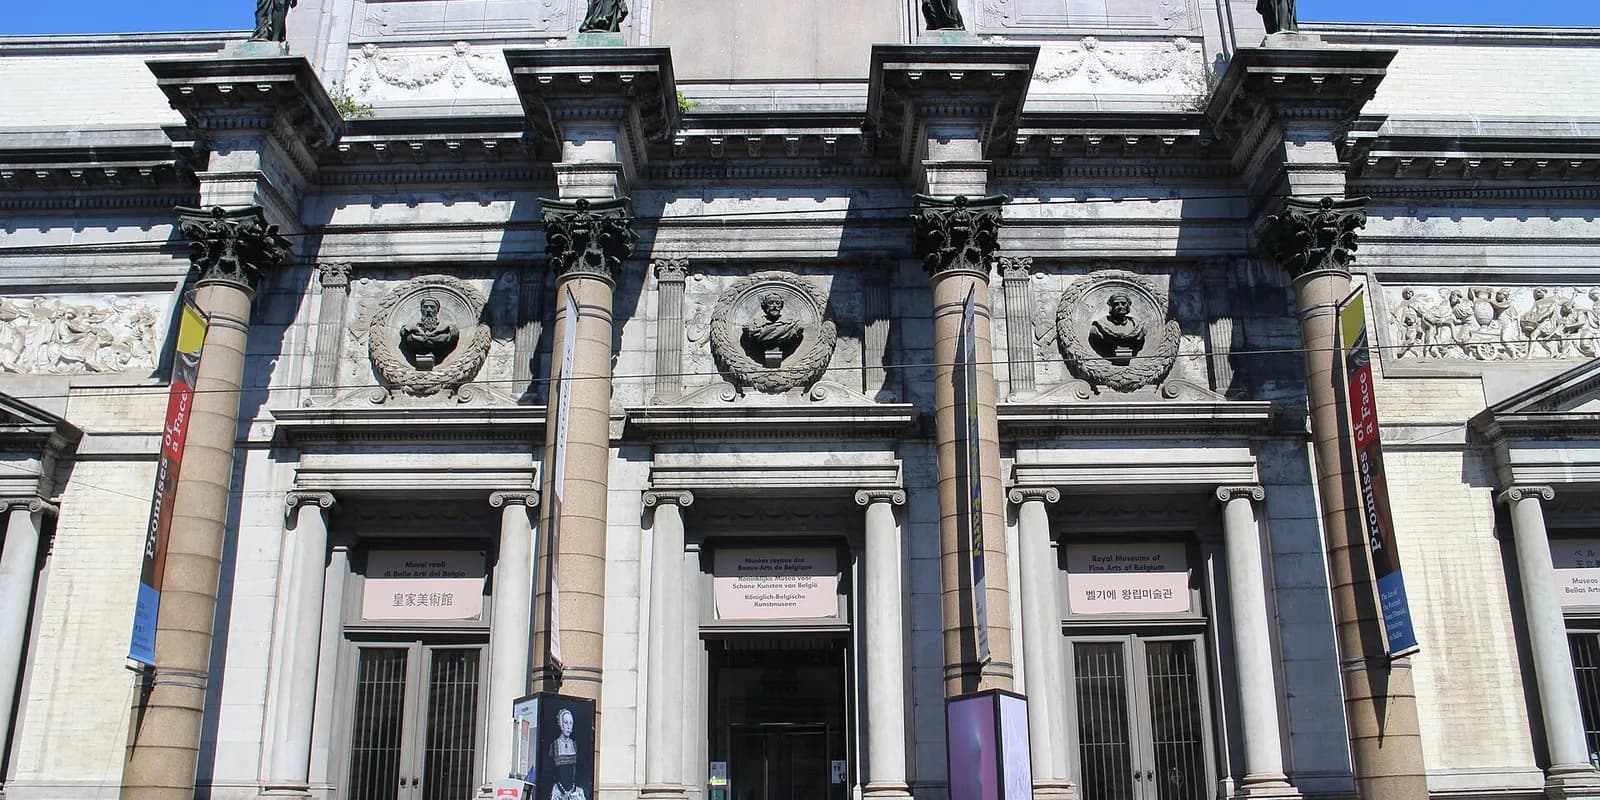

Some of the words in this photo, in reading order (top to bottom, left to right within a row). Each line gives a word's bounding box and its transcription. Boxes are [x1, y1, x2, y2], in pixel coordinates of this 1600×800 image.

[1360, 372, 1371, 421] Face
[174, 389, 188, 436] Face
[1354, 422, 1364, 442] of
[1366, 424, 1374, 435] a
[172, 444, 179, 453] a
[146, 456, 168, 560] Promises
[165, 422, 173, 447] of
[1360, 451, 1382, 553] Promises
[1092, 554, 1113, 563] Royal
[1115, 554, 1150, 562] Museums
[1152, 553, 1161, 561] of
[784, 564, 813, 572] Belgique
[1134, 564, 1165, 573] Belgium
[1085, 589, 1117, 601] 벨기에
[1121, 588, 1173, 601] 왕립미술관
[1565, 586, 1586, 594] Bellas
[392, 593, 454, 607] 皇家美術館
[744, 593, 806, 601] Königlich-Belgische
